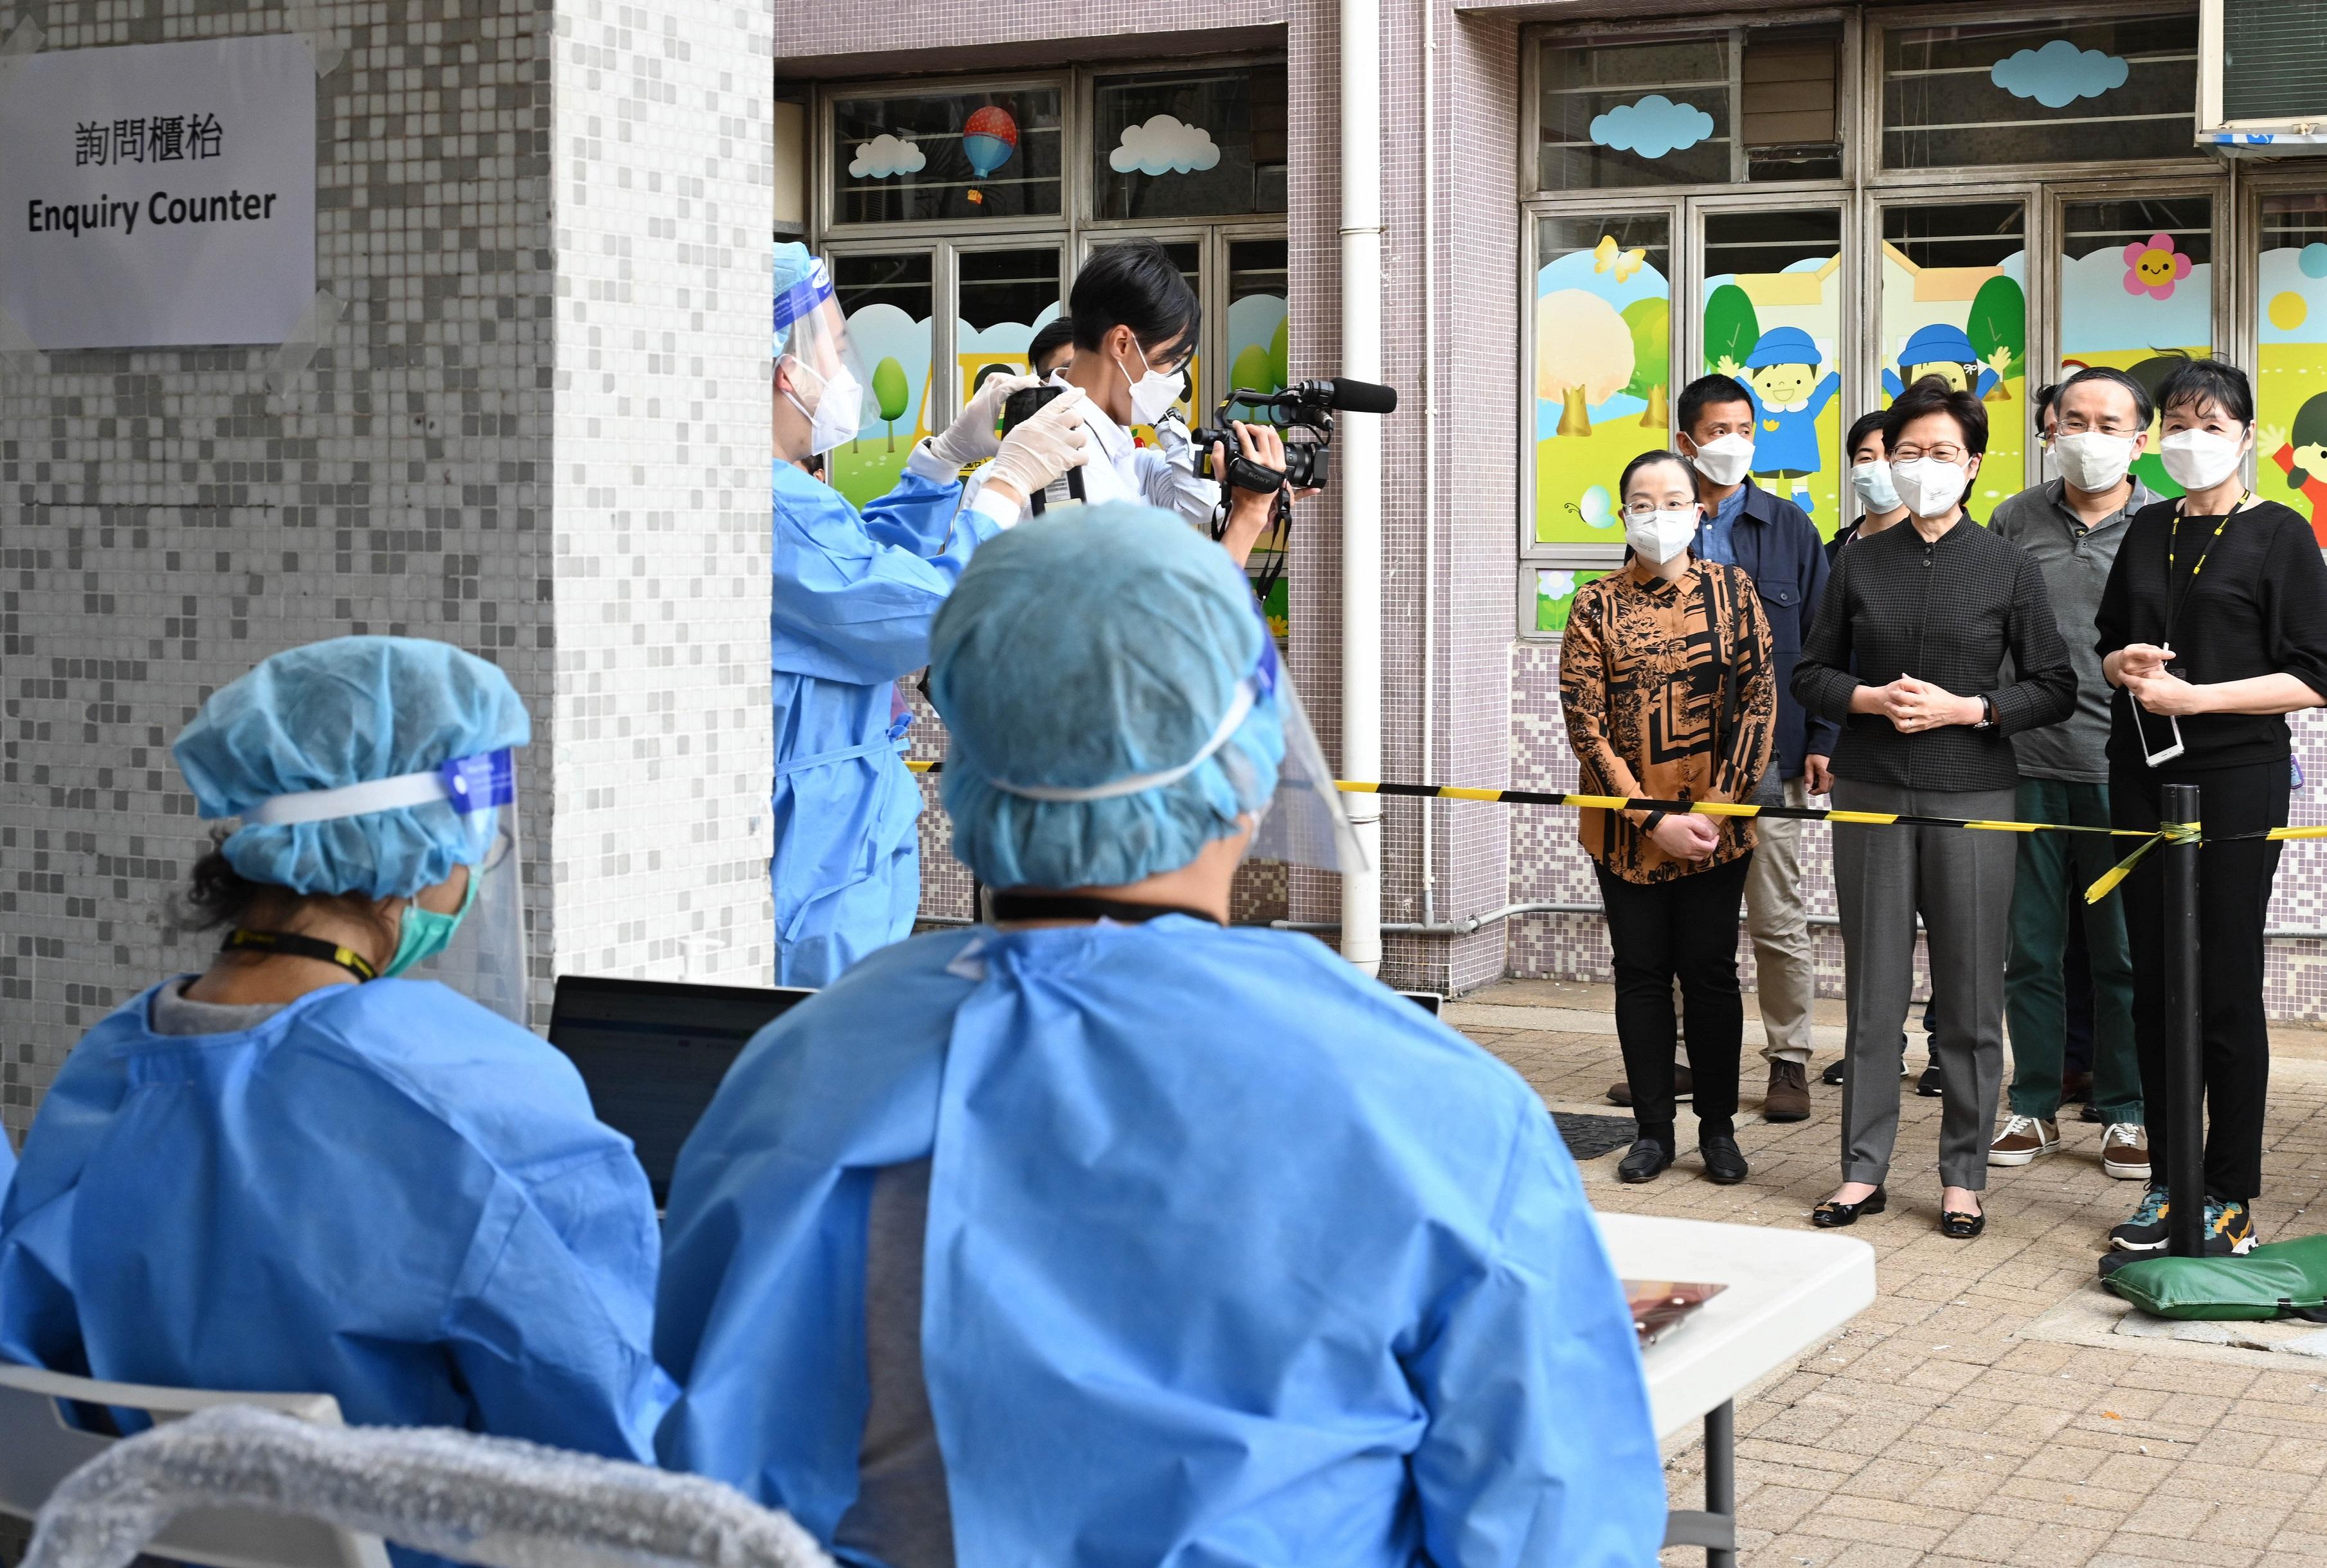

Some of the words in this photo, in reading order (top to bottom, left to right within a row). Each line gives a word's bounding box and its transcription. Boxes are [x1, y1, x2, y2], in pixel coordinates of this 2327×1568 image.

[75, 112, 223, 166] 詢問櫃枱
[28, 193, 139, 238] Enquiry
[148, 190, 277, 225] Counter
[1248, 472, 1270, 483] SONY
